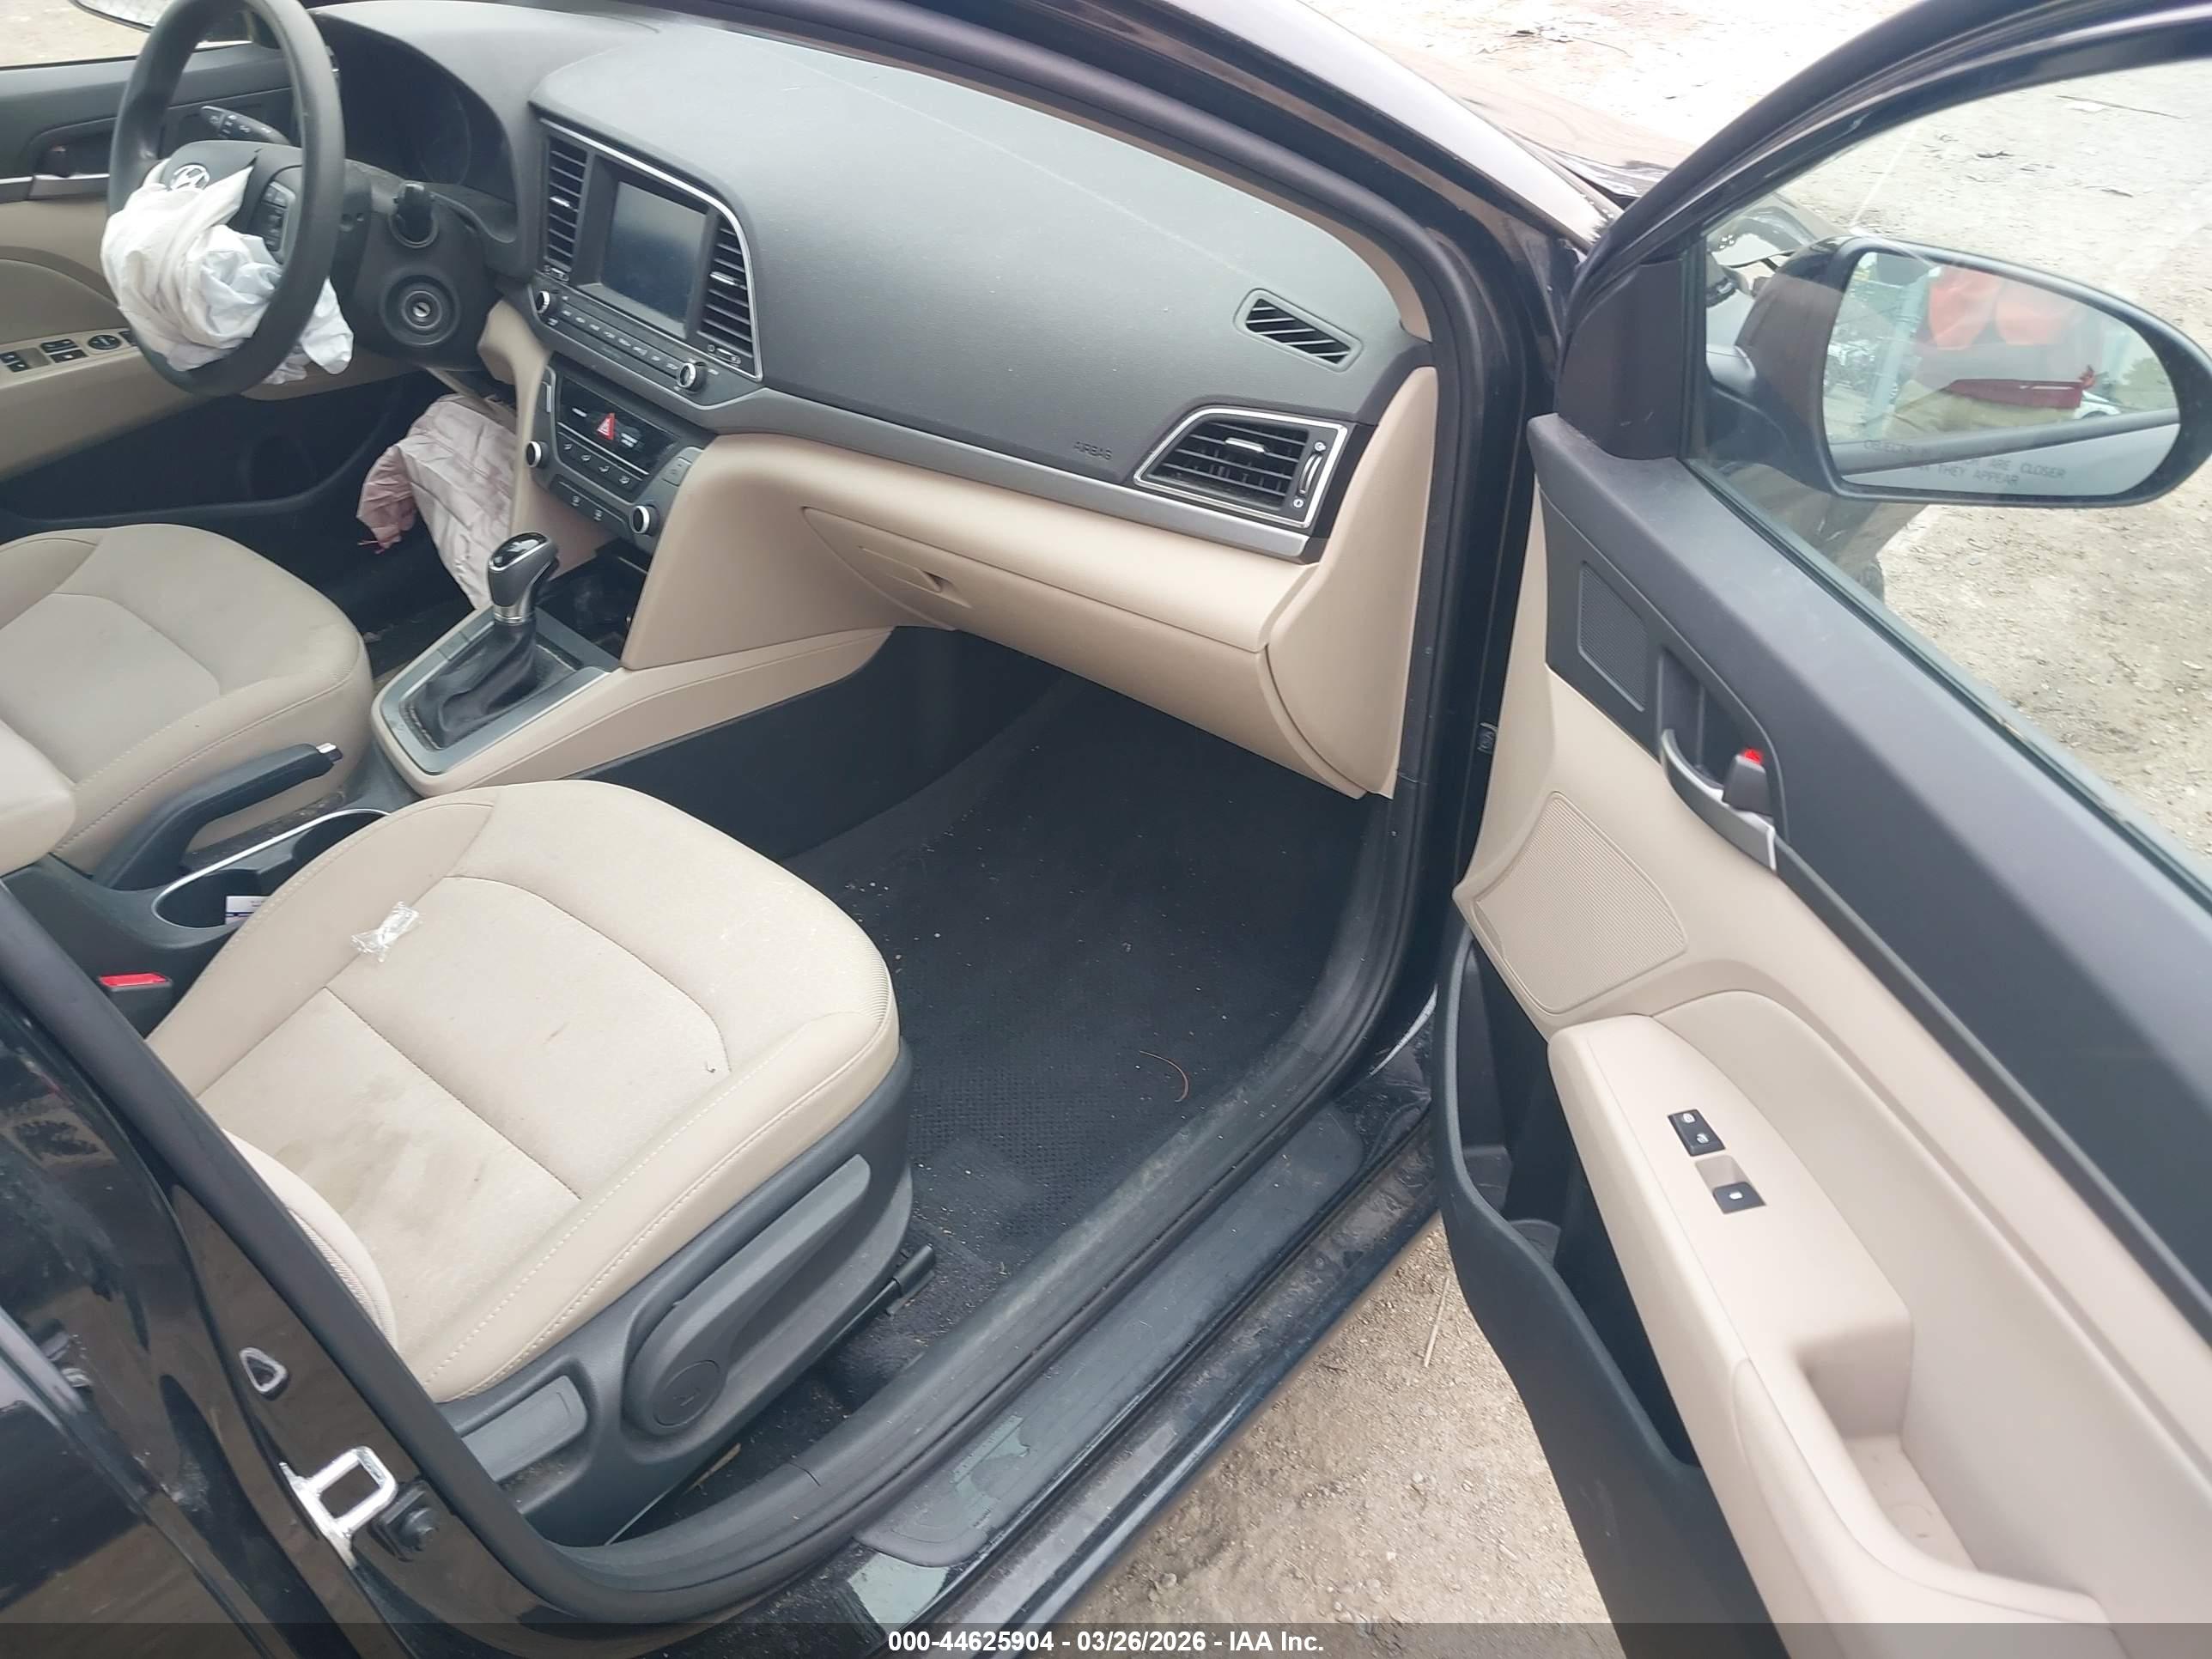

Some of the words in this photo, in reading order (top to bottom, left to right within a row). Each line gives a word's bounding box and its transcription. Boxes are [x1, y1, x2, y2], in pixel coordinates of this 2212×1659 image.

[1938, 465, 1966, 478] THEY
[1972, 470, 2020, 486] APPEAR
[2021, 461, 2067, 480] CLOSER
